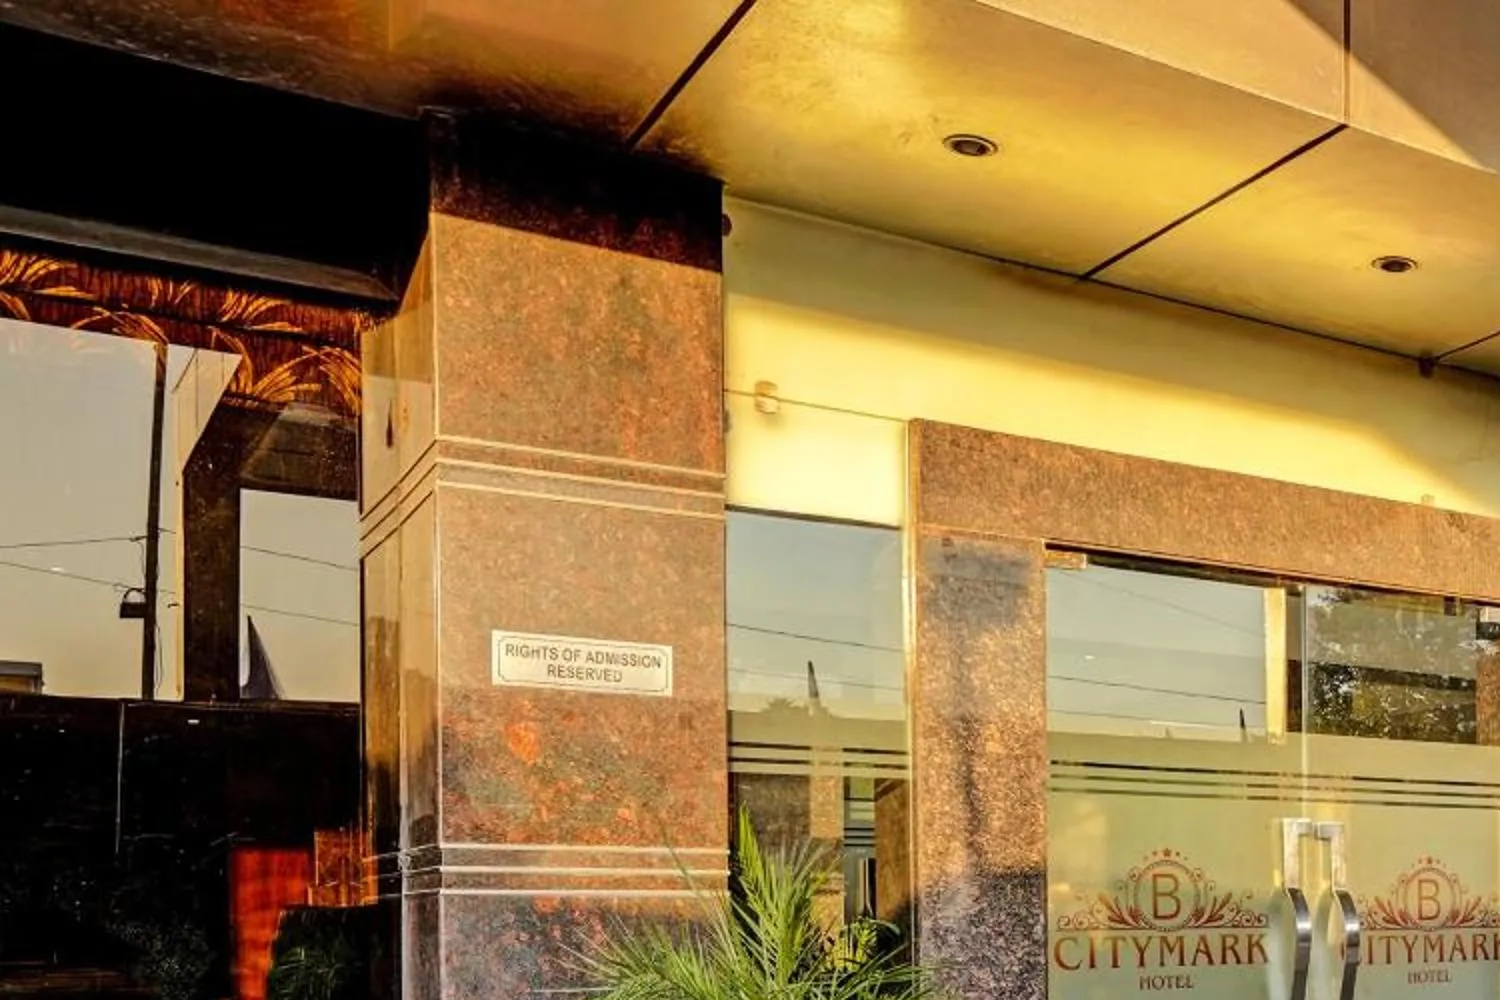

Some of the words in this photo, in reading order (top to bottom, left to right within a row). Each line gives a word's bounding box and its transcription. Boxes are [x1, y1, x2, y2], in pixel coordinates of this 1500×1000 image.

[505, 643, 560, 661] RIGHTS
[562, 648, 580, 663] OF
[585, 650, 662, 669] ADMISSION
[546, 664, 623, 683] RESERVED
[1151, 873, 1182, 920] B
[1416, 878, 1441, 921] B
[1053, 931, 1269, 971] CITYMARK
[1139, 974, 1194, 990] HOTEL
[1408, 969, 1452, 984] HOTEL
